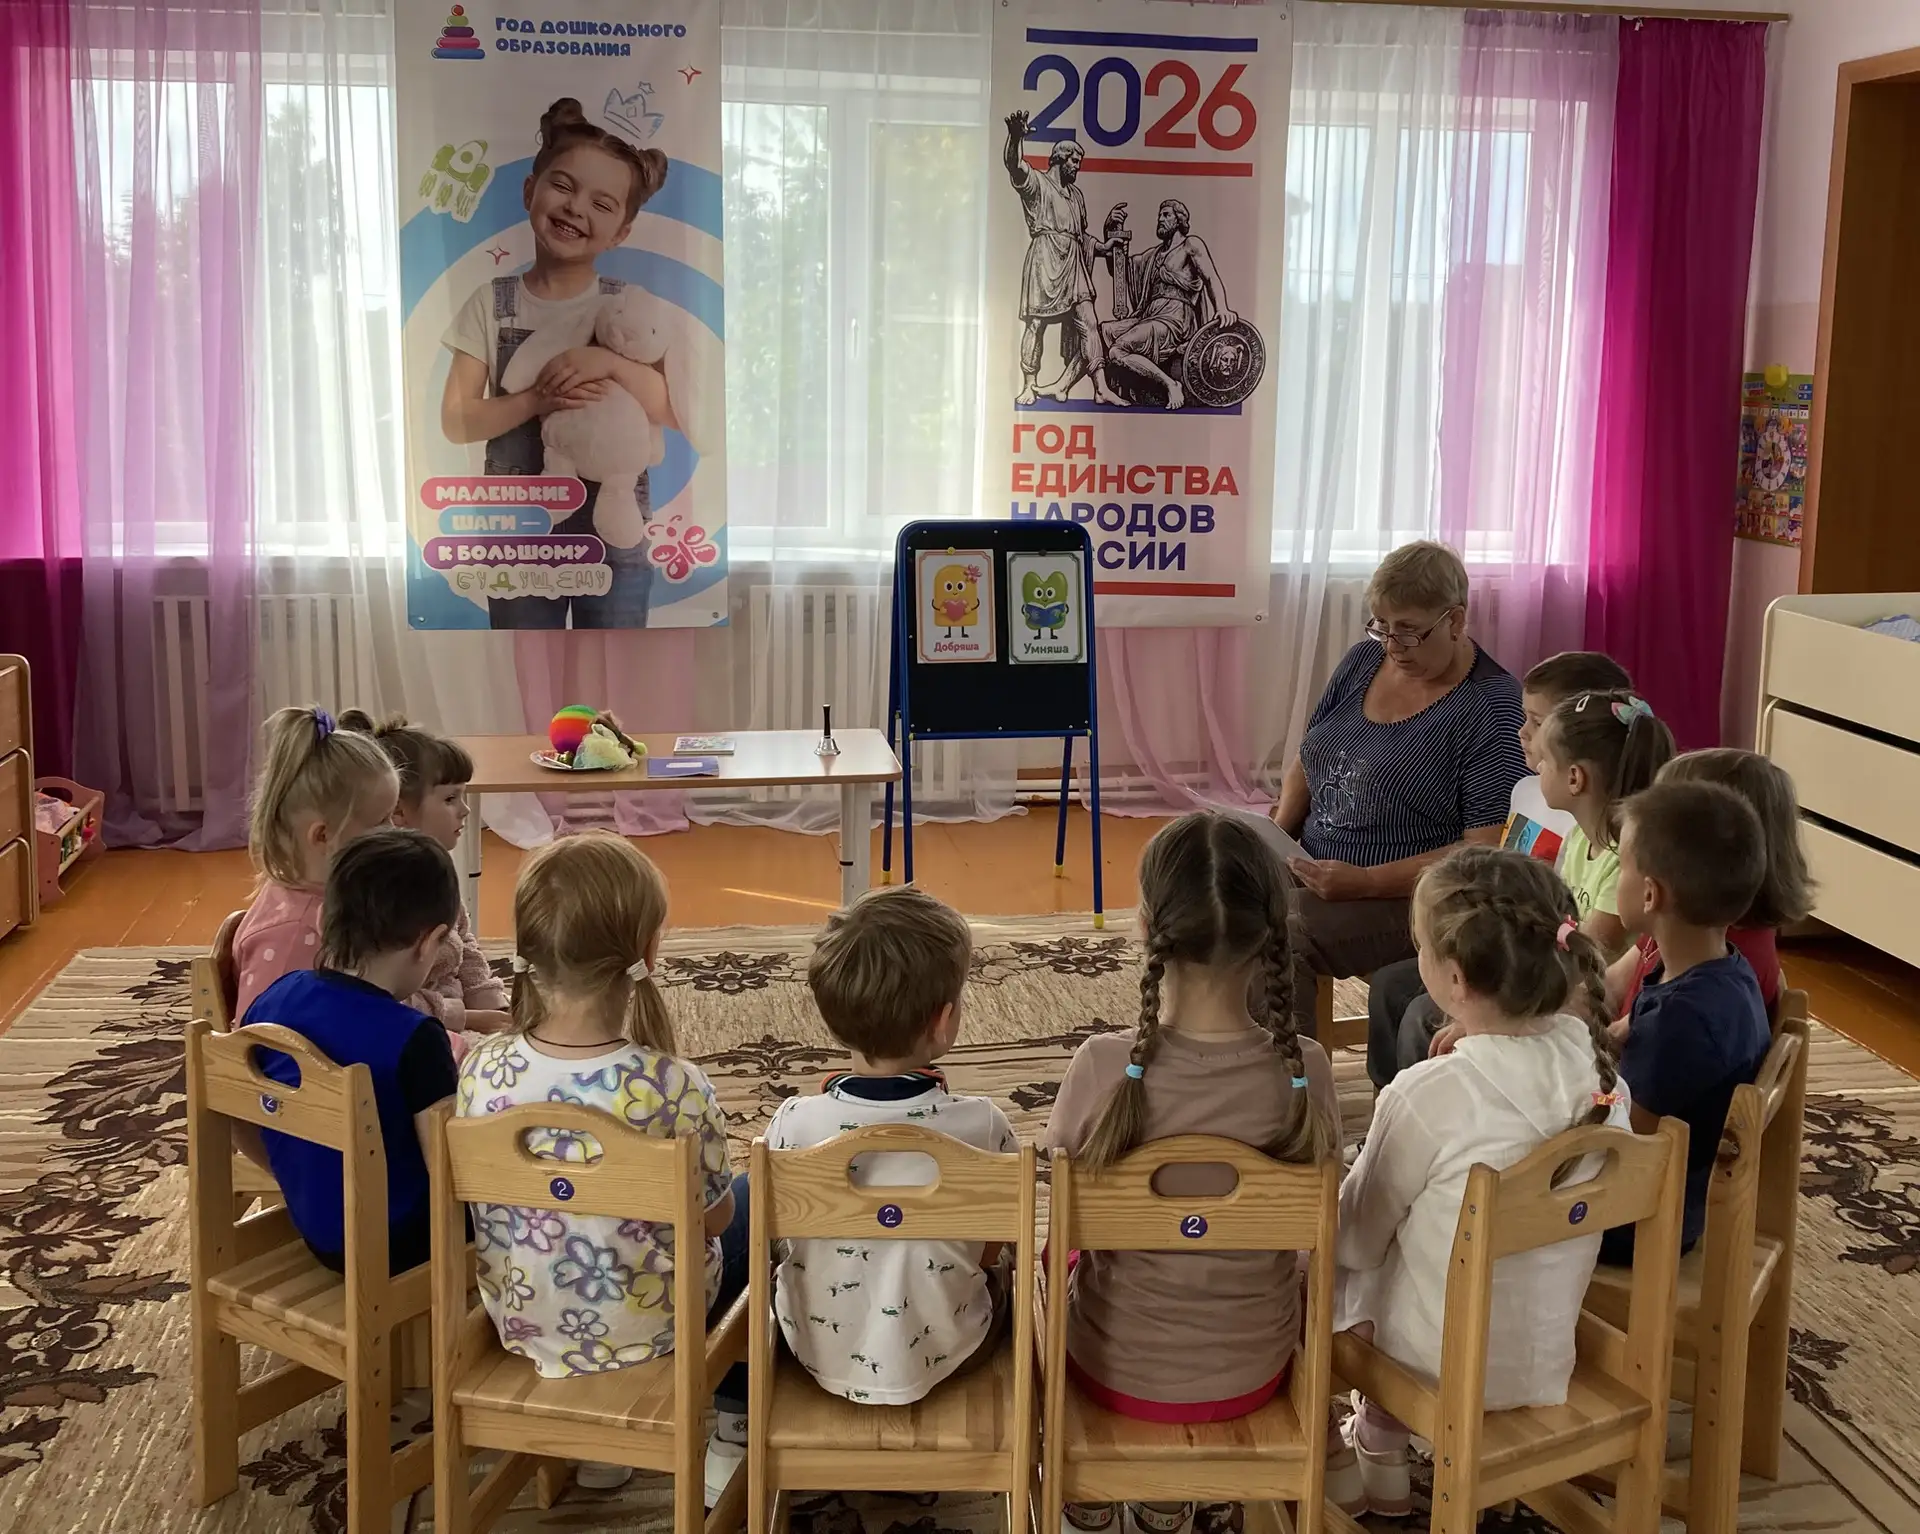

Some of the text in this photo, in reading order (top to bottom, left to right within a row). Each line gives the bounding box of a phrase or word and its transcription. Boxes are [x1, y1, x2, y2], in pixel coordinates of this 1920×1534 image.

[495, 17, 687, 38] ГОД ДОШКОЛЬНОГО
[495, 38, 631, 57] ОБРАЗОВАНИЯ
[1023, 54, 1257, 151] 2026
[1012, 423, 1096, 460] ГОД
[1011, 462, 1240, 498] ЕДИНСТВА
[435, 485, 570, 502] МАЛЕНЬКИЕ
[452, 514, 517, 531] ШАГИ
[438, 543, 590, 561] К БОЛЬШОМУ
[1097, 541, 1187, 571] СИИ
[456, 569, 606, 593] БУДУЩЕМУ
[933, 642, 980, 653] Добряша
[1023, 643, 1070, 655] Умняша
[557, 1181, 569, 1197] 2
[884, 1207, 896, 1223] 2
[1574, 1204, 1585, 1220] 2
[1187, 1215, 1200, 1234] 2
